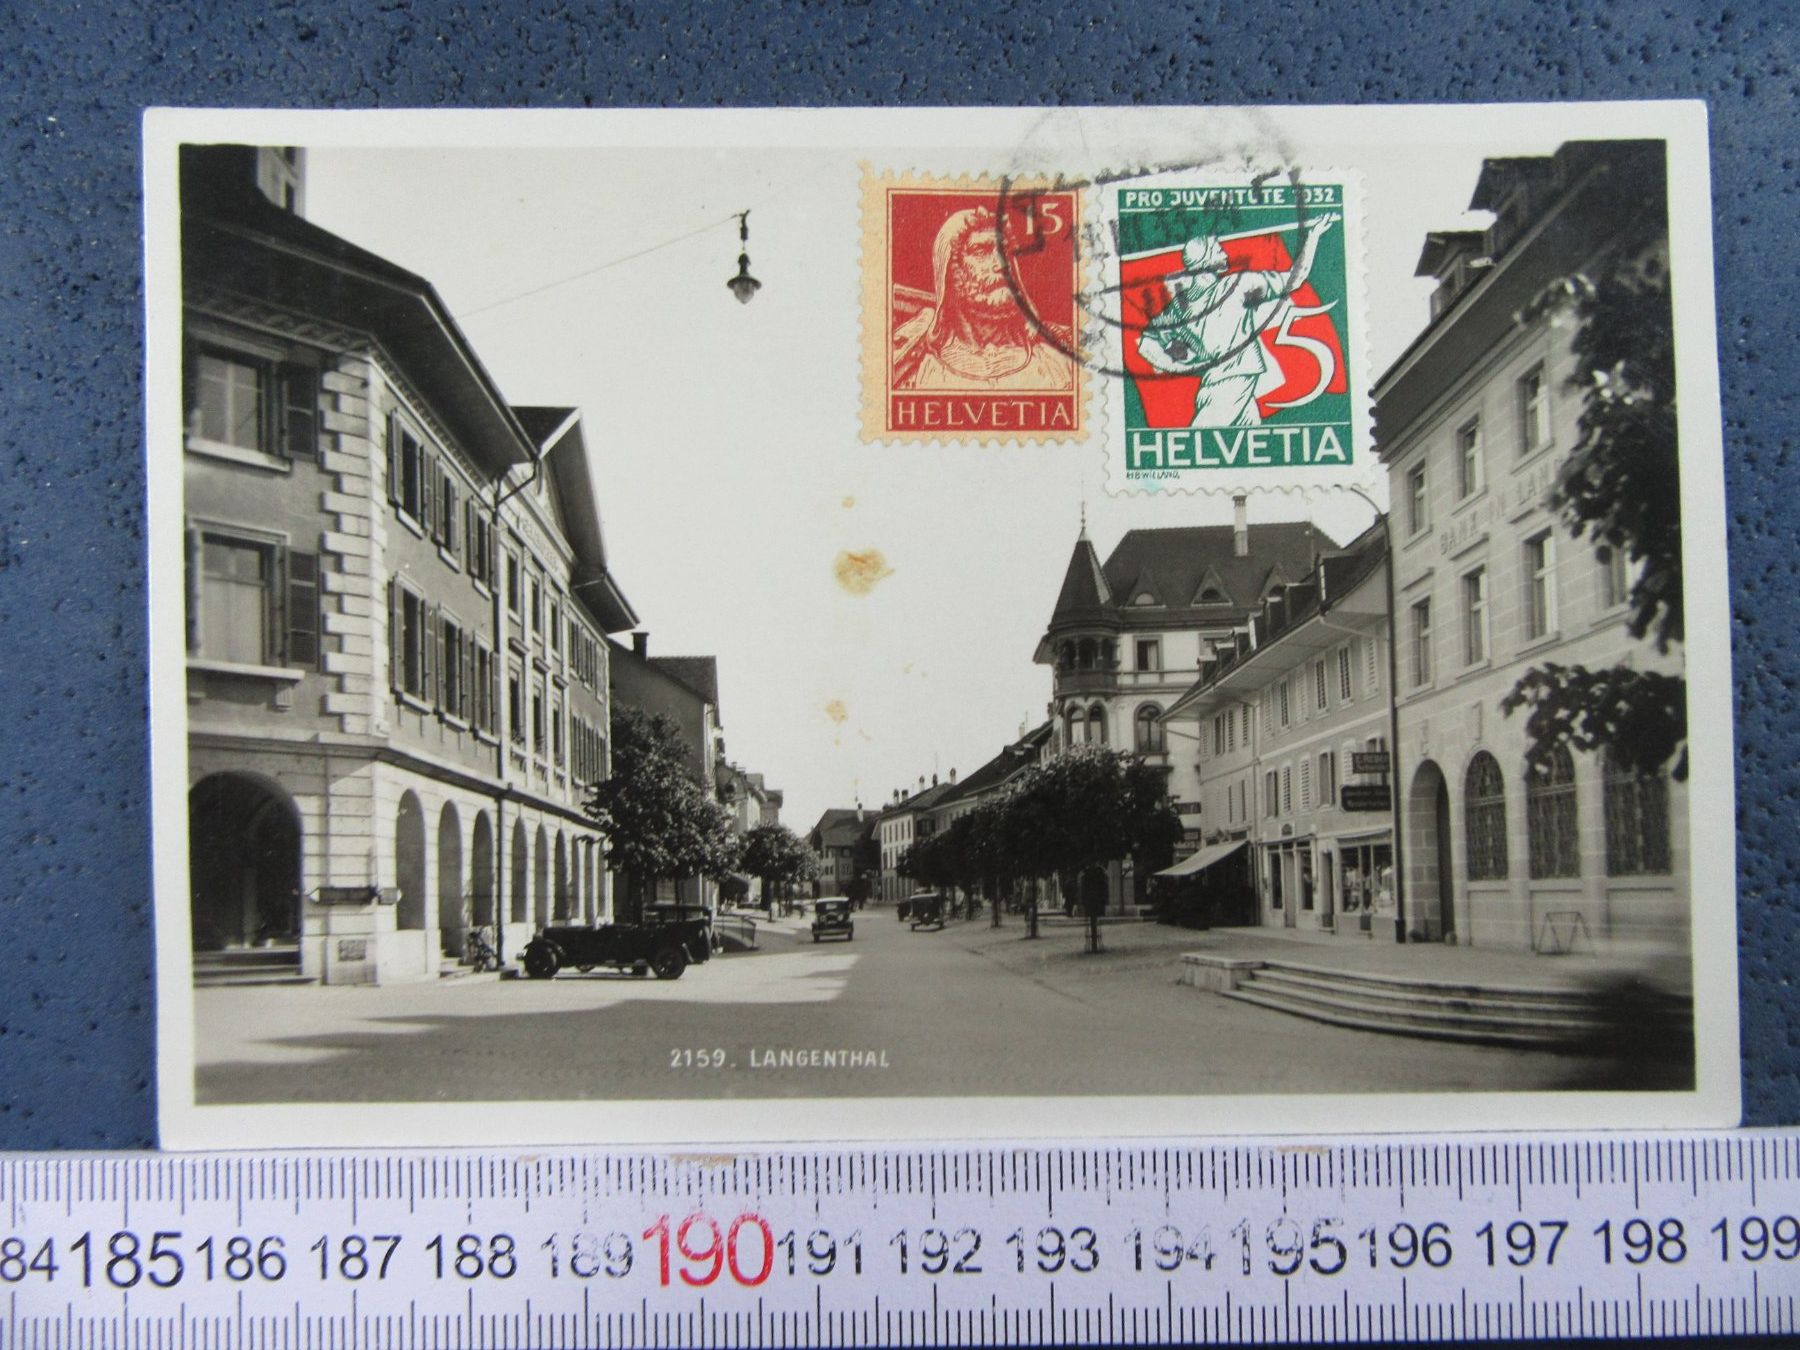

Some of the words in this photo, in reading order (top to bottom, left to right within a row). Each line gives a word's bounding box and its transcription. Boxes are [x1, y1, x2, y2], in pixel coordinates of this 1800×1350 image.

[1125, 190, 1163, 208] PRO
[1025, 202, 1064, 236] 15
[1264, 299, 1339, 409] 5
[898, 401, 1071, 427] HELVETIA
[1132, 426, 1346, 468] HELVETIA
[70, 1230, 185, 1288] 185
[196, 1236, 287, 1282] 186
[310, 1234, 402, 1281] 187
[425, 1234, 518, 1280] 188
[541, 1232, 634, 1279] 189
[642, 1212, 775, 1287] 190
[776, 1229, 863, 1276] 191
[889, 1226, 983, 1275] 192
[1005, 1225, 1101, 1273] 193
[1123, 1223, 1219, 1272] 194
[1229, 1217, 1348, 1276] 195
[1357, 1221, 1453, 1269] 196
[1475, 1220, 1570, 1267] 197
[1592, 1217, 1688, 1264] 198
[1710, 1215, 1800, 1262] 199
